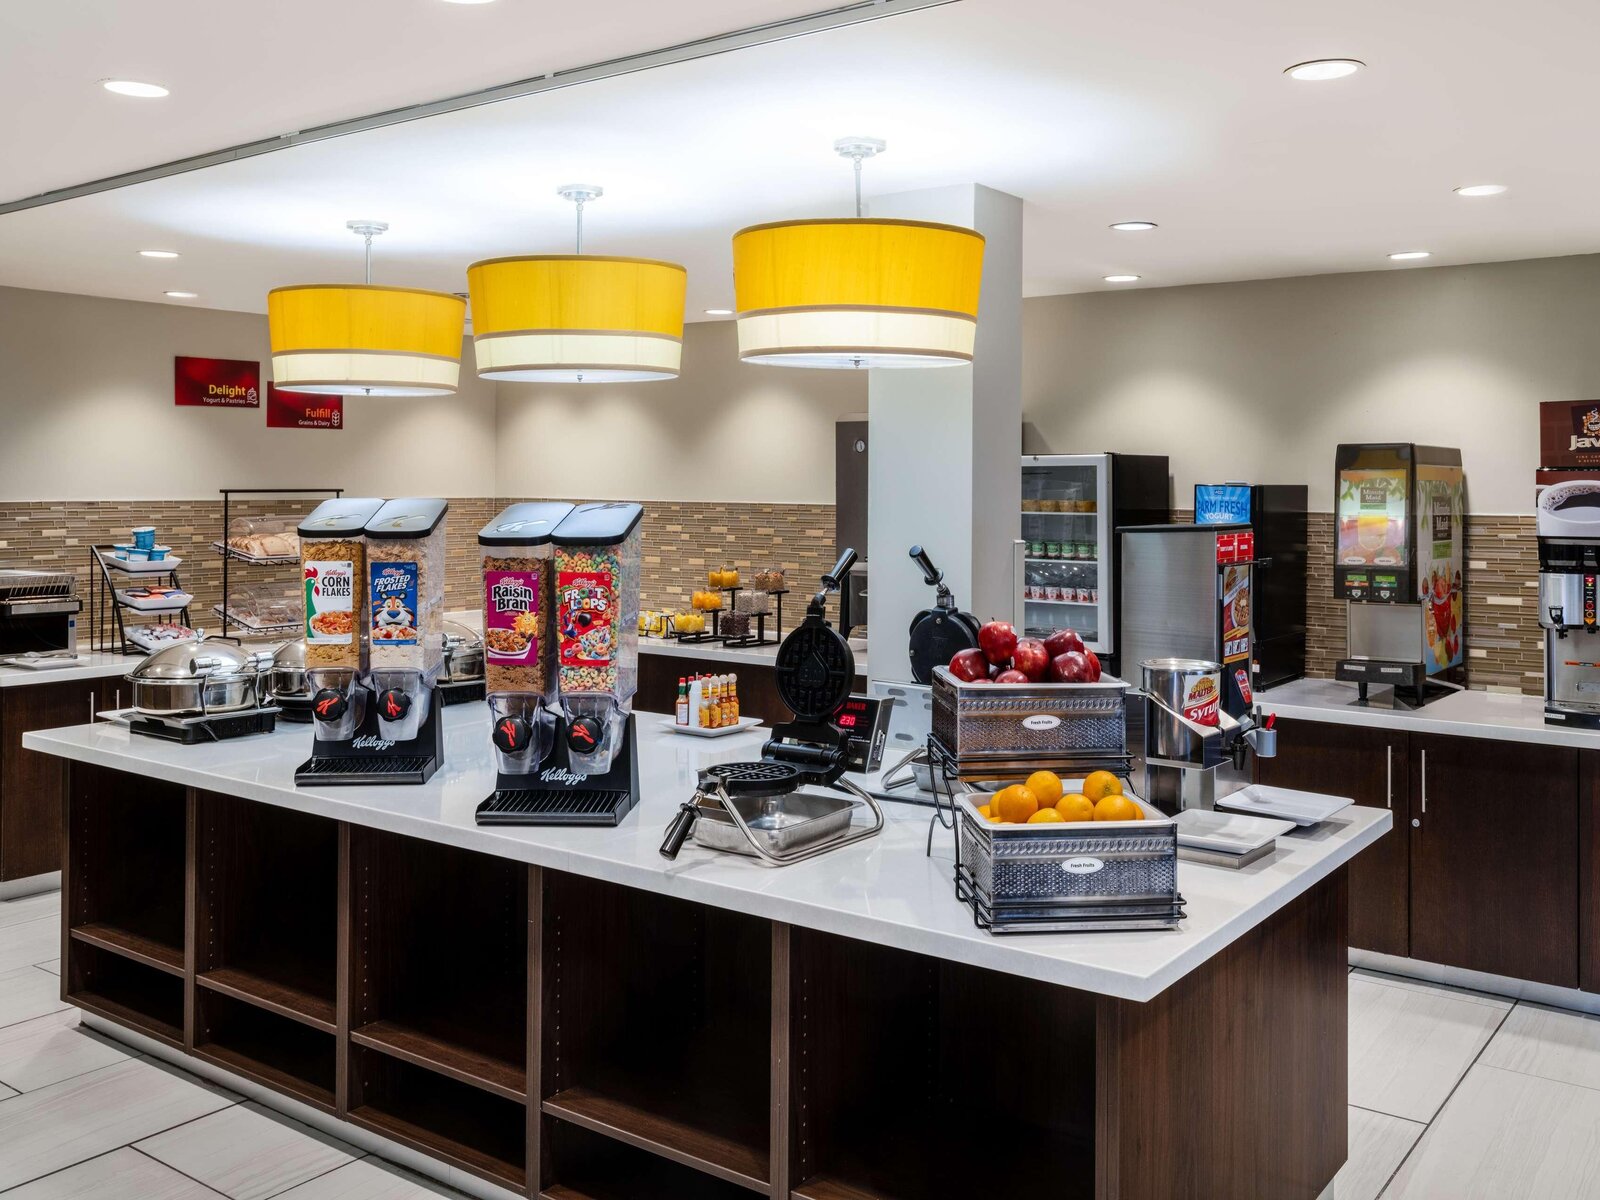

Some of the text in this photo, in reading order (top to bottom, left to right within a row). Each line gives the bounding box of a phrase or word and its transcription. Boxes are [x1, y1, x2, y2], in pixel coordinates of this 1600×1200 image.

[209, 384, 246, 398] Delight
[305, 408, 331, 418] Fulfill
[1219, 500, 1248, 517] FRESH
[1206, 512, 1234, 521] YOGURT
[321, 576, 350, 587] CORN
[374, 575, 411, 586] FROSTED
[322, 587, 351, 597] FLAKES
[376, 582, 407, 592] FLAKES
[492, 585, 533, 602] Raisin
[564, 588, 604, 602] FROOT
[496, 598, 529, 612] Bran
[570, 597, 607, 611] LOOPS
